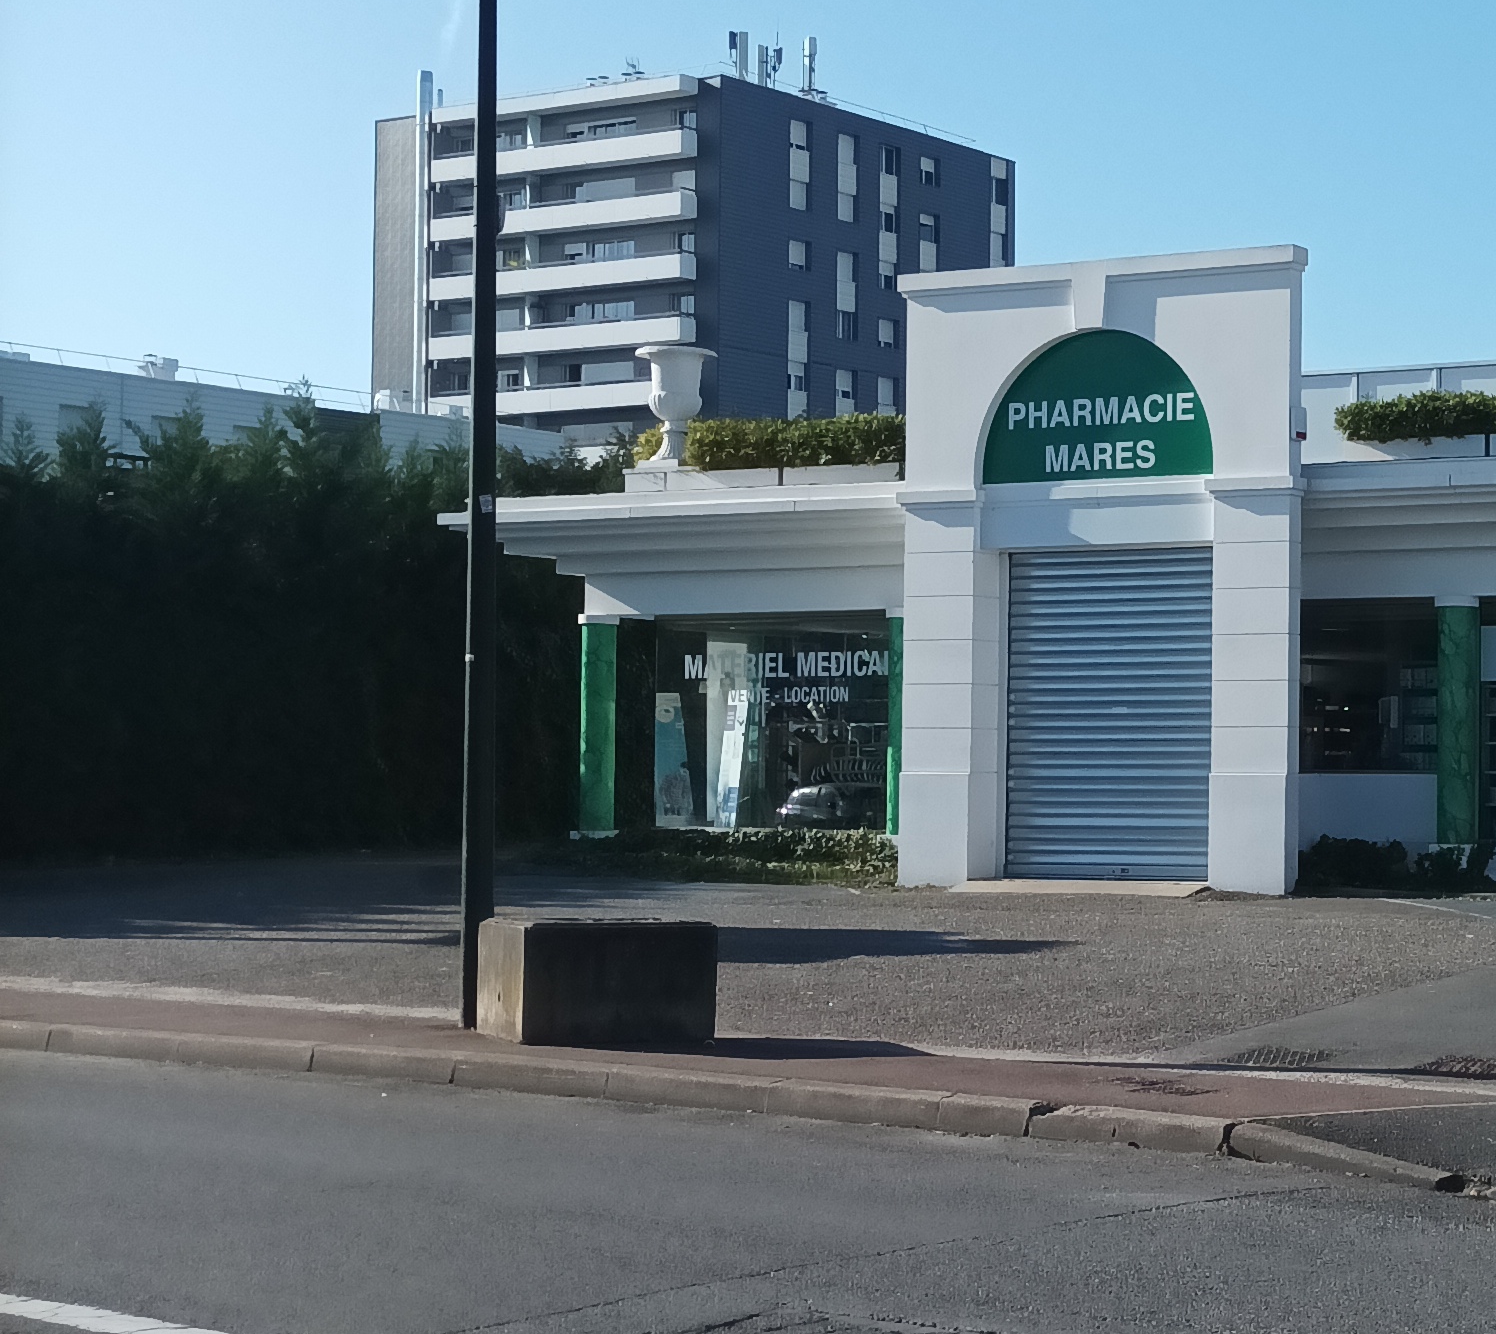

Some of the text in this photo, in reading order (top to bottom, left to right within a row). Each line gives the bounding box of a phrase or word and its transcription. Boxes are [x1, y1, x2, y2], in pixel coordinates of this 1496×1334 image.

[1008, 392, 1195, 430] PHARMACIE
[1045, 439, 1156, 473] MARES
[684, 652, 789, 679] MATERIEL
[784, 686, 849, 703] LOCATION
